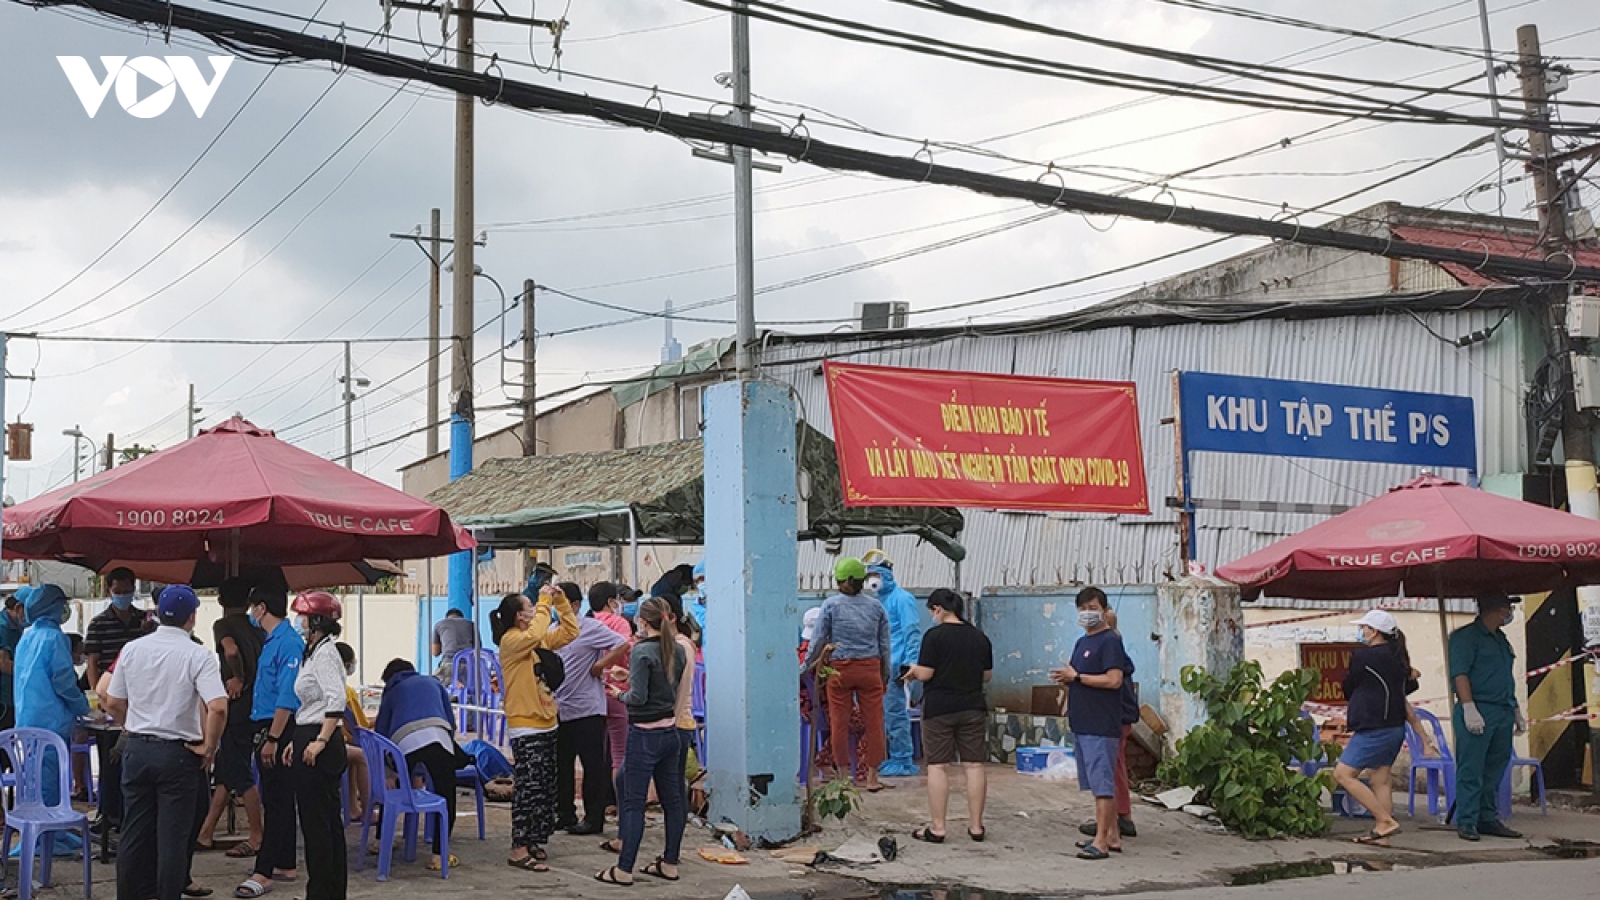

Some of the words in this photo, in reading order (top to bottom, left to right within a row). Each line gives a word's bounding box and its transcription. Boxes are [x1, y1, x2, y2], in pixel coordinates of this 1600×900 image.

[941, 388, 972, 432] ĐIỂM
[971, 405, 1000, 434] KHAI
[1000, 400, 1023, 436] BÁO
[1023, 408, 1033, 436] Y
[1033, 398, 1050, 437] TẾ
[1207, 394, 1268, 433] KHU
[1279, 396, 1333, 441] TẬP
[1344, 401, 1398, 443] THỂ
[1408, 412, 1451, 447] P/S
[864, 440, 886, 477] VÀ
[885, 437, 909, 478] LẤY
[910, 437, 938, 478] MẪU
[936, 444, 961, 479] XÉT
[960, 446, 1005, 489] NGHIỆM
[1003, 443, 1031, 483] TẦM
[1031, 447, 1059, 484] SOÁT
[1059, 456, 1086, 491] DỊCH
[1087, 457, 1130, 488] COVID-19
[116, 510, 166, 526] 1900
[172, 508, 225, 526] 8024
[305, 509, 353, 529] TRUE
[359, 515, 415, 532] CAFE
[1325, 553, 1383, 567] TRUE
[1390, 546, 1448, 564] CAFE
[1516, 543, 1561, 558] 1900
[1566, 542, 1600, 557] 802
[1308, 651, 1337, 669] KHU
